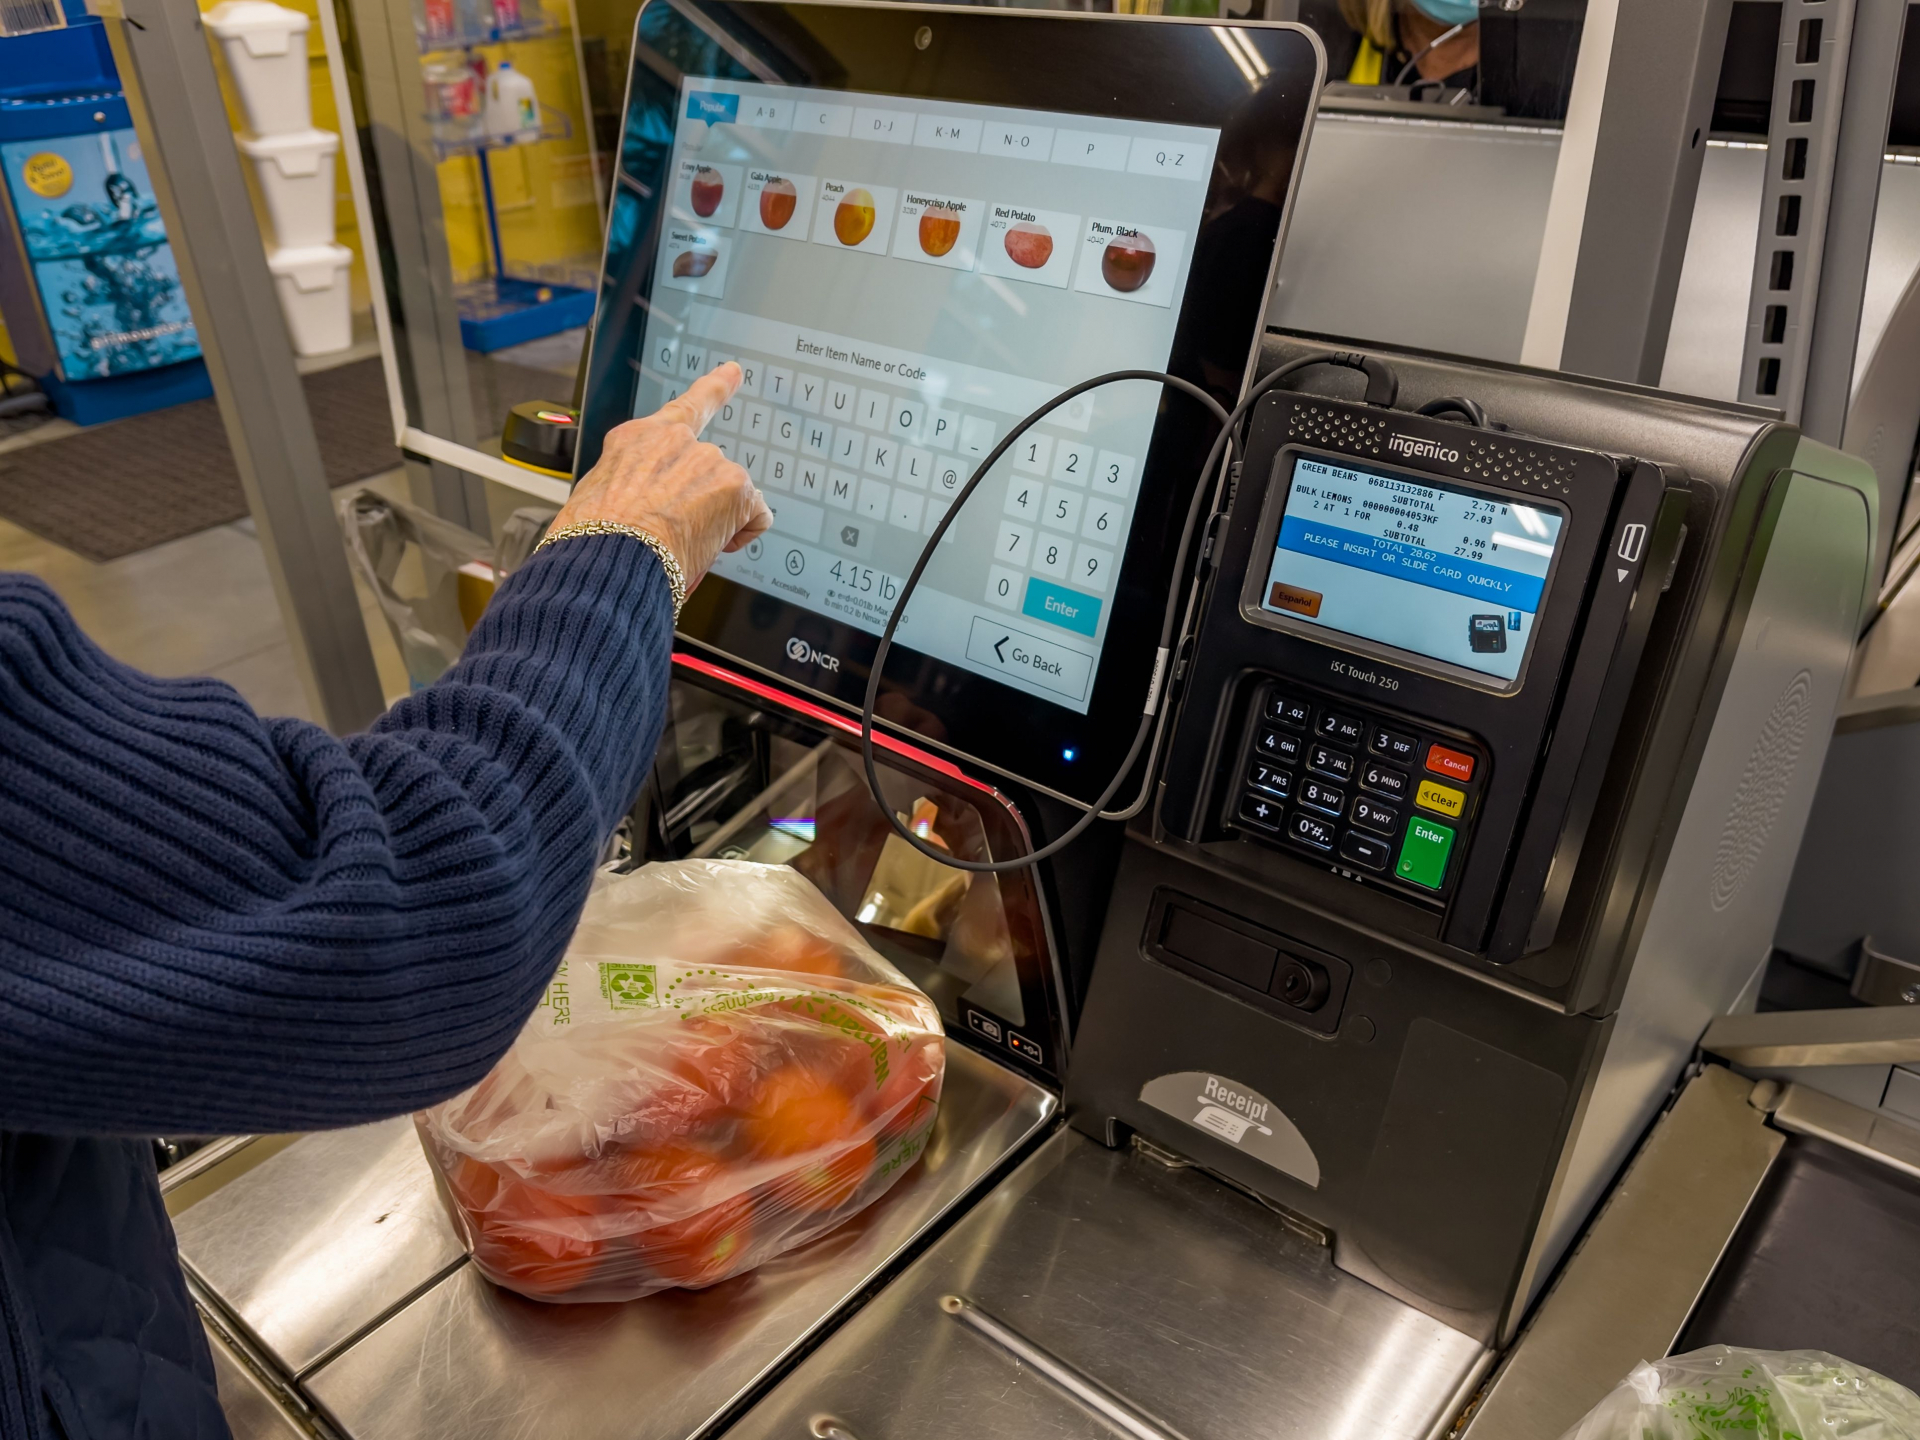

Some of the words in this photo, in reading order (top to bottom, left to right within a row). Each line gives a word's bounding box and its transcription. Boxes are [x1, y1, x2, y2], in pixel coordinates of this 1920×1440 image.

[757, 107, 762, 116] A
[770, 108, 775, 118] B
[820, 113, 827, 124] C
[874, 119, 881, 130] D
[888, 120, 893, 132] J
[935, 126, 943, 137] K
[950, 128, 960, 139] M
[1004, 135, 1012, 145] N
[1021, 136, 1030, 147] O
[1087, 144, 1095, 155] P
[1156, 152, 1165, 165] Q
[1175, 154, 1184, 166] Z
[751, 171, 764, 181] Gala
[825, 182, 844, 193] Peach
[906, 194, 945, 210] Honeycrisp
[946, 201, 967, 213] Apple
[995, 207, 1009, 218] Red
[1011, 210, 1036, 222] Potato
[1091, 222, 1114, 235] Plum,
[1115, 226, 1139, 239] Black
[796, 335, 823, 356] Enter
[826, 346, 848, 362] Item
[851, 352, 882, 370] Name
[884, 363, 896, 373] or
[898, 364, 926, 381] Code
[661, 348, 671, 367] Q
[687, 356, 700, 371] W
[744, 370, 754, 386] R
[774, 377, 784, 393] T
[804, 384, 814, 401] Y
[835, 392, 846, 410] U
[900, 410, 912, 428] O
[936, 419, 946, 436] P
[722, 404, 733, 421] D
[752, 414, 761, 428] F
[781, 422, 792, 438] G
[811, 430, 822, 448] H
[844, 440, 852, 456] J
[876, 448, 887, 466] K
[911, 458, 918, 476] L
[942, 470, 957, 489] @
[1388, 432, 1459, 463] ingenico
[1028, 444, 1036, 462] 1
[1066, 454, 1078, 472] 2
[1107, 464, 1120, 483] 3
[746, 452, 756, 469] V
[775, 462, 784, 479] B
[804, 471, 815, 489] N
[834, 480, 848, 499] M
[1296, 485, 1317, 496] BULK
[1321, 491, 1352, 504] LEMONS
[1302, 462, 1327, 474] GREEN
[1332, 469, 1358, 481] BEANS
[1368, 478, 1433, 498] 068113132886
[1438, 493, 1445, 501] F
[1472, 500, 1496, 514] 2.78
[1017, 490, 1028, 508] 4
[1056, 500, 1068, 518] 5
[1097, 512, 1108, 530] 6
[1392, 495, 1435, 512] SUBTOTAL
[1463, 511, 1493, 525] 27.03
[1324, 504, 1334, 512] AT
[1344, 508, 1349, 516] 1
[1354, 510, 1370, 520] FOR
[1397, 521, 1419, 532] 0.48
[1463, 536, 1486, 549] 0.96
[1373, 539, 1404, 553] TOTAL
[1410, 548, 1436, 561] 28.62
[1383, 529, 1426, 546] SUBTOTAL
[1453, 546, 1483, 560] 27.99
[1008, 534, 1020, 552] 7
[1046, 546, 1058, 564] 8
[1087, 558, 1098, 576] 9
[1304, 532, 1339, 548] PLEASE
[1344, 543, 1377, 558] INSERT
[1382, 553, 1396, 562] OR
[1401, 556, 1428, 571] SLIDE
[1433, 565, 1462, 579] CARD
[1467, 574, 1513, 593] QUICKLY
[771, 577, 810, 599] Accessibility
[830, 560, 873, 592] 4.15
[879, 575, 896, 600] lb
[998, 578, 1009, 596] 0
[1044, 596, 1079, 618] Enter
[1278, 591, 1312, 607] Español
[844, 605, 854, 615] 0.2
[874, 605, 888, 616] Max
[811, 651, 840, 672] NCR
[1012, 648, 1030, 664] Go
[1032, 654, 1062, 676] Back
[1330, 660, 1346, 674] iSC
[1348, 663, 1376, 684] Touch
[1379, 676, 1399, 691] 250
[1276, 701, 1283, 713] 1
[1326, 718, 1336, 731] 2
[1341, 725, 1357, 736] ABC
[1266, 735, 1274, 747] 4
[1281, 742, 1295, 752] GHI
[1378, 735, 1388, 747] 3
[1394, 742, 1410, 752] DEF
[1317, 752, 1326, 764] 5
[1333, 760, 1347, 770] JKL
[1444, 759, 1468, 772] Cancel
[1258, 768, 1267, 780] 7
[1272, 775, 1287, 786] PRS
[1368, 770, 1378, 782] 6
[1381, 776, 1400, 788] MNO
[1307, 786, 1317, 798] 8
[1323, 792, 1338, 804] TUV
[1431, 793, 1457, 808] Clear
[1359, 805, 1368, 818] 9
[1373, 812, 1390, 823] WXY
[1415, 826, 1444, 843] Enter
[553, 983, 570, 1025] HERE
[704, 992, 774, 1014] freshness
[820, 1006, 890, 1090] Walmart
[1204, 1076, 1269, 1122] Receipt
[882, 1144, 919, 1178] HERE
